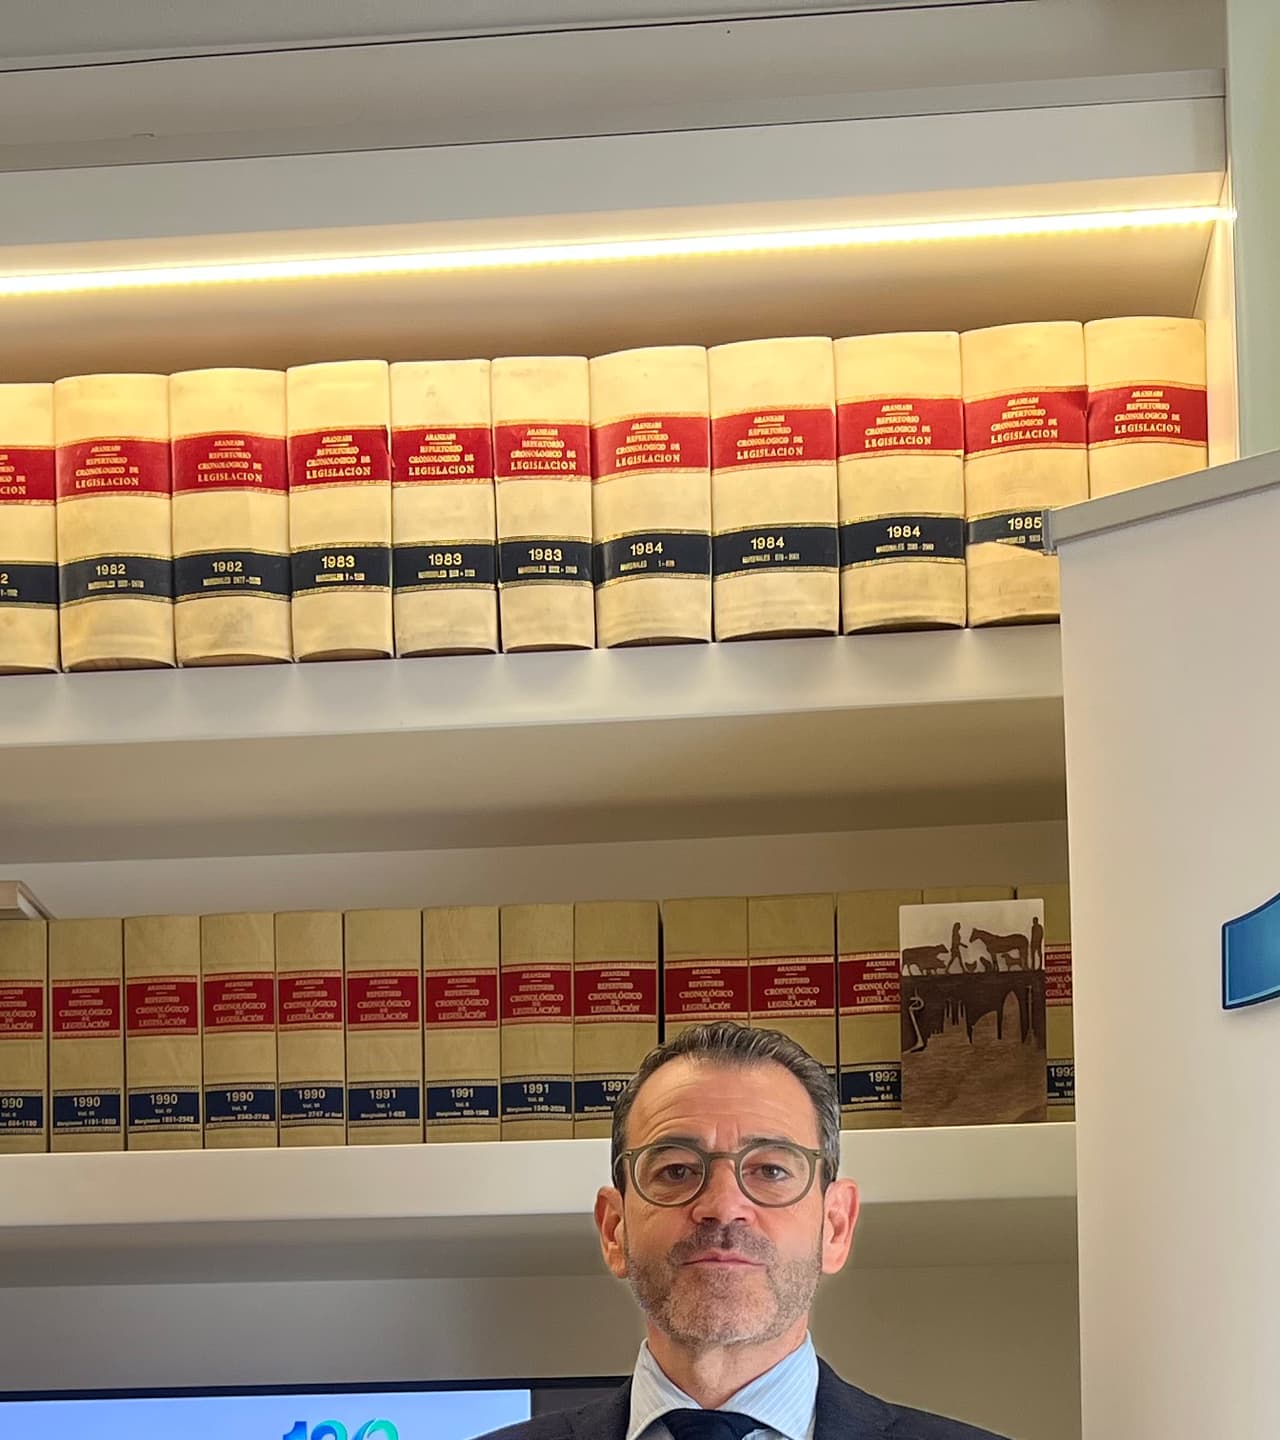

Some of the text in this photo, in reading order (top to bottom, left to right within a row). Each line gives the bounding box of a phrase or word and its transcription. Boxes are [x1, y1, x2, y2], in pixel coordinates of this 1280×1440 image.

[1114, 424, 1181, 434] LEGISLACION
[865, 435, 932, 448] LEGISLACION
[991, 429, 1058, 444] LEGISLACION
[737, 447, 803, 460] LEGISLACION
[511, 460, 577, 472] LEGISLACION
[616, 454, 680, 467] LEGISLACION
[306, 466, 371, 479] LEGISLACION
[408, 464, 474, 476] LEGISLACION
[75, 477, 139, 488] LEGISLACION
[197, 472, 263, 483] LEGISLACION
[1007, 516, 1042, 530] 1985
[886, 525, 921, 538] 1984
[630, 542, 663, 556] 1984
[750, 536, 785, 550] 1984
[428, 553, 462, 566] 1983
[528, 548, 562, 561] 1983
[212, 561, 243, 573] 1982
[321, 556, 355, 569] 1983
[95, 563, 126, 576] 1982
[869, 1071, 897, 1082] 1992
[522, 1083, 549, 1094] 1991
[602, 1081, 626, 1091] 1991
[226, 1091, 254, 1102] 1990
[297, 1088, 326, 1099] 1990
[369, 1088, 396, 1099] 1991
[450, 1087, 474, 1098] 1991
[72, 1096, 100, 1107] 1990
[150, 1094, 178, 1105] 1990
